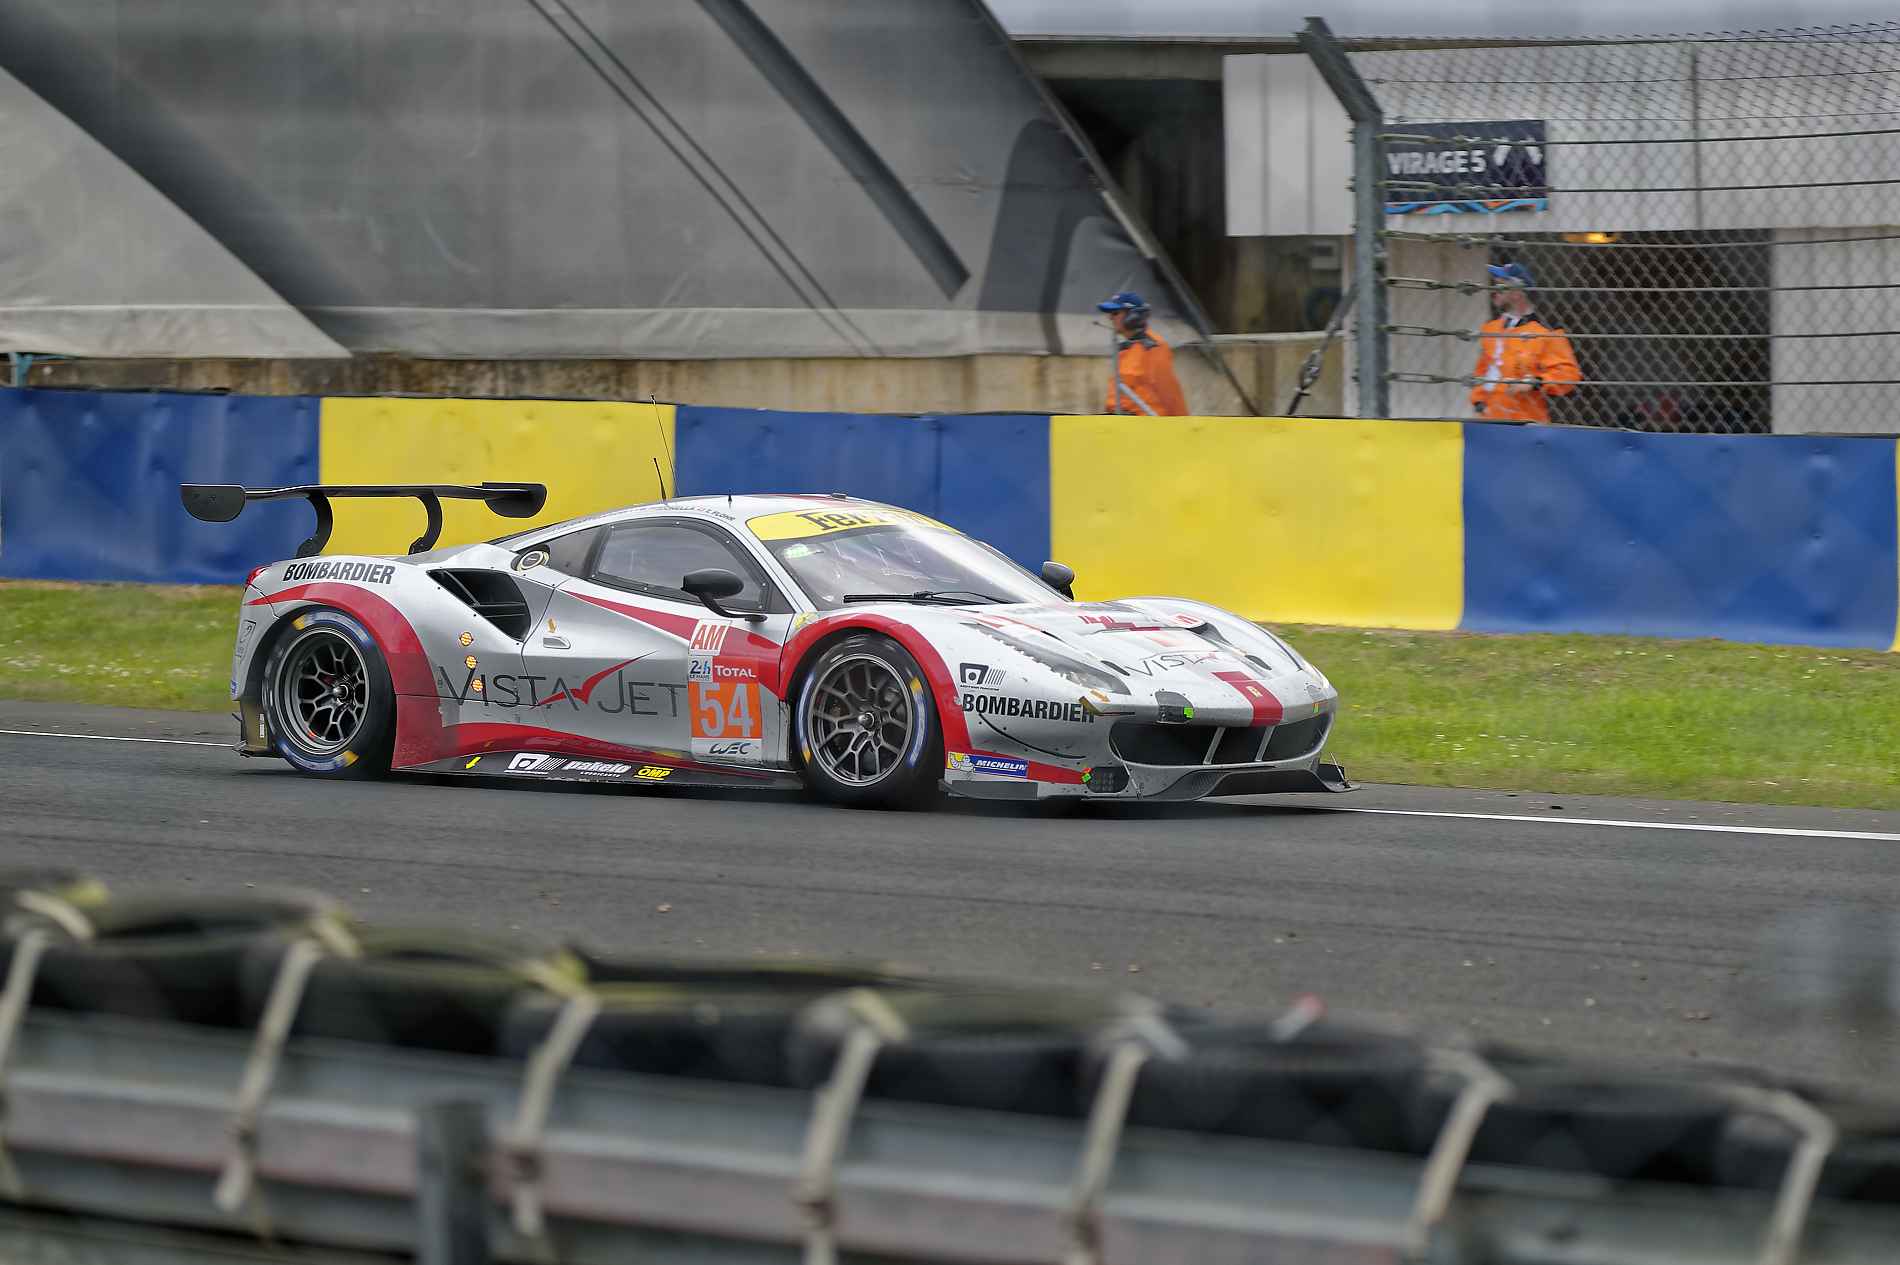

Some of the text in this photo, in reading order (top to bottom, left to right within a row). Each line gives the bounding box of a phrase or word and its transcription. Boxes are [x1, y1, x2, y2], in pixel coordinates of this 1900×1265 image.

[283, 562, 395, 584] BOMBARDIER
[691, 625, 727, 650] AM
[715, 665, 757, 678] TOTAL
[699, 682, 755, 737] 54
[709, 741, 751, 755] WEC
[976, 760, 1028, 771] MICHELIN
[637, 768, 671, 778] OMP
